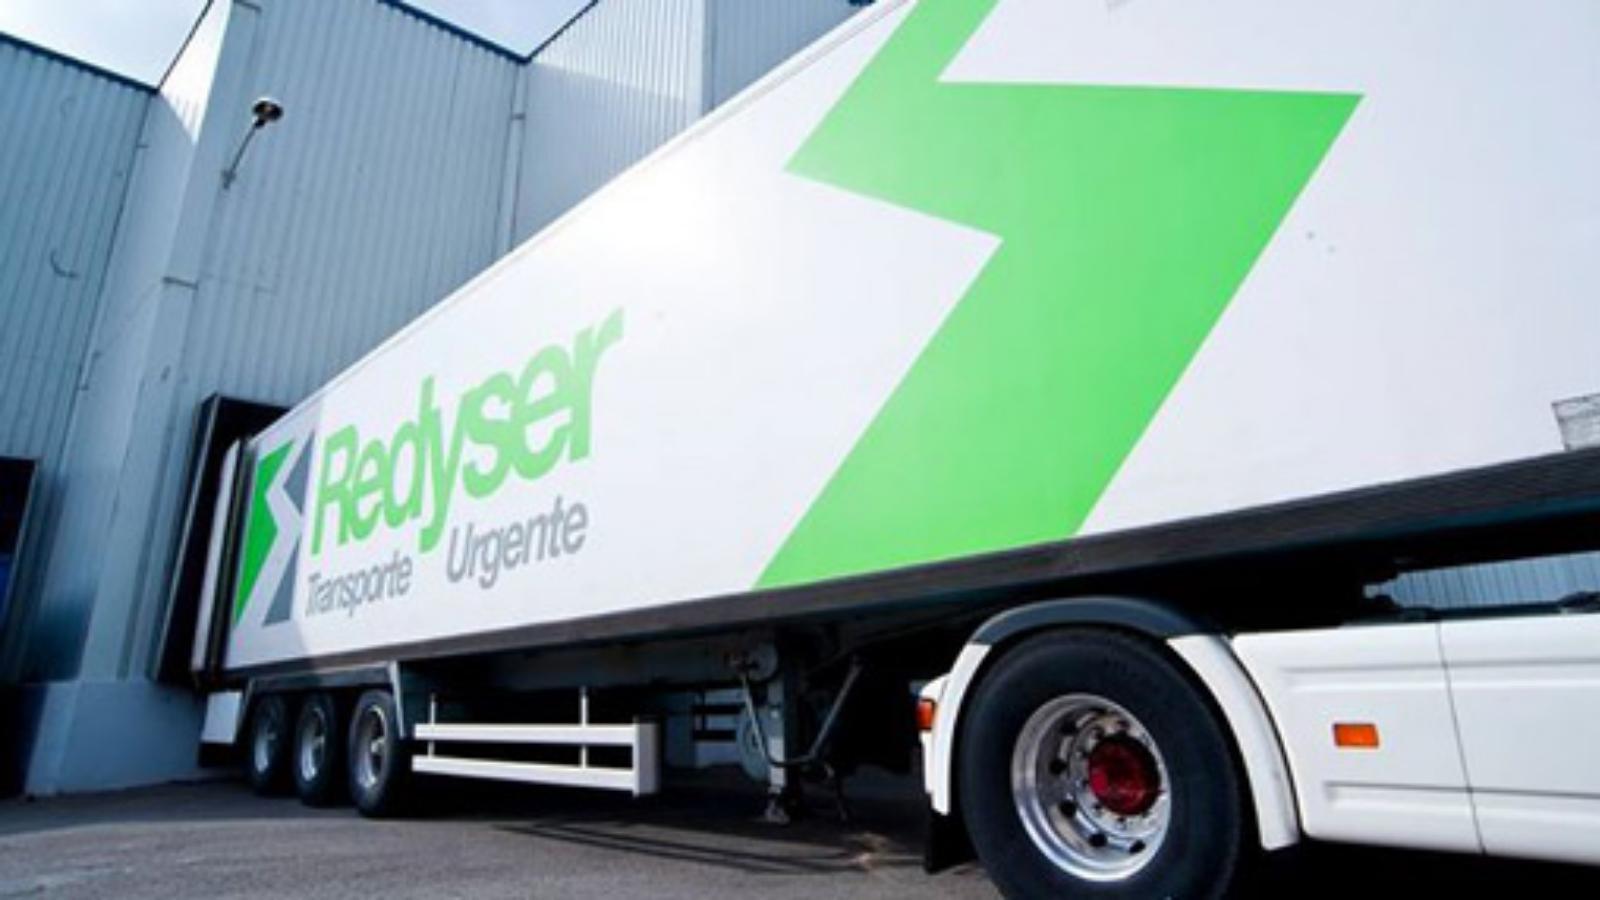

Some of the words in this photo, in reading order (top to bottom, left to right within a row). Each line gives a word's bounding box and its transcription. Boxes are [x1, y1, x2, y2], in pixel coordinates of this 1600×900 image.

[312, 307, 624, 555] Redyser
[306, 551, 413, 617] Transporte
[447, 496, 588, 588] Urgente
